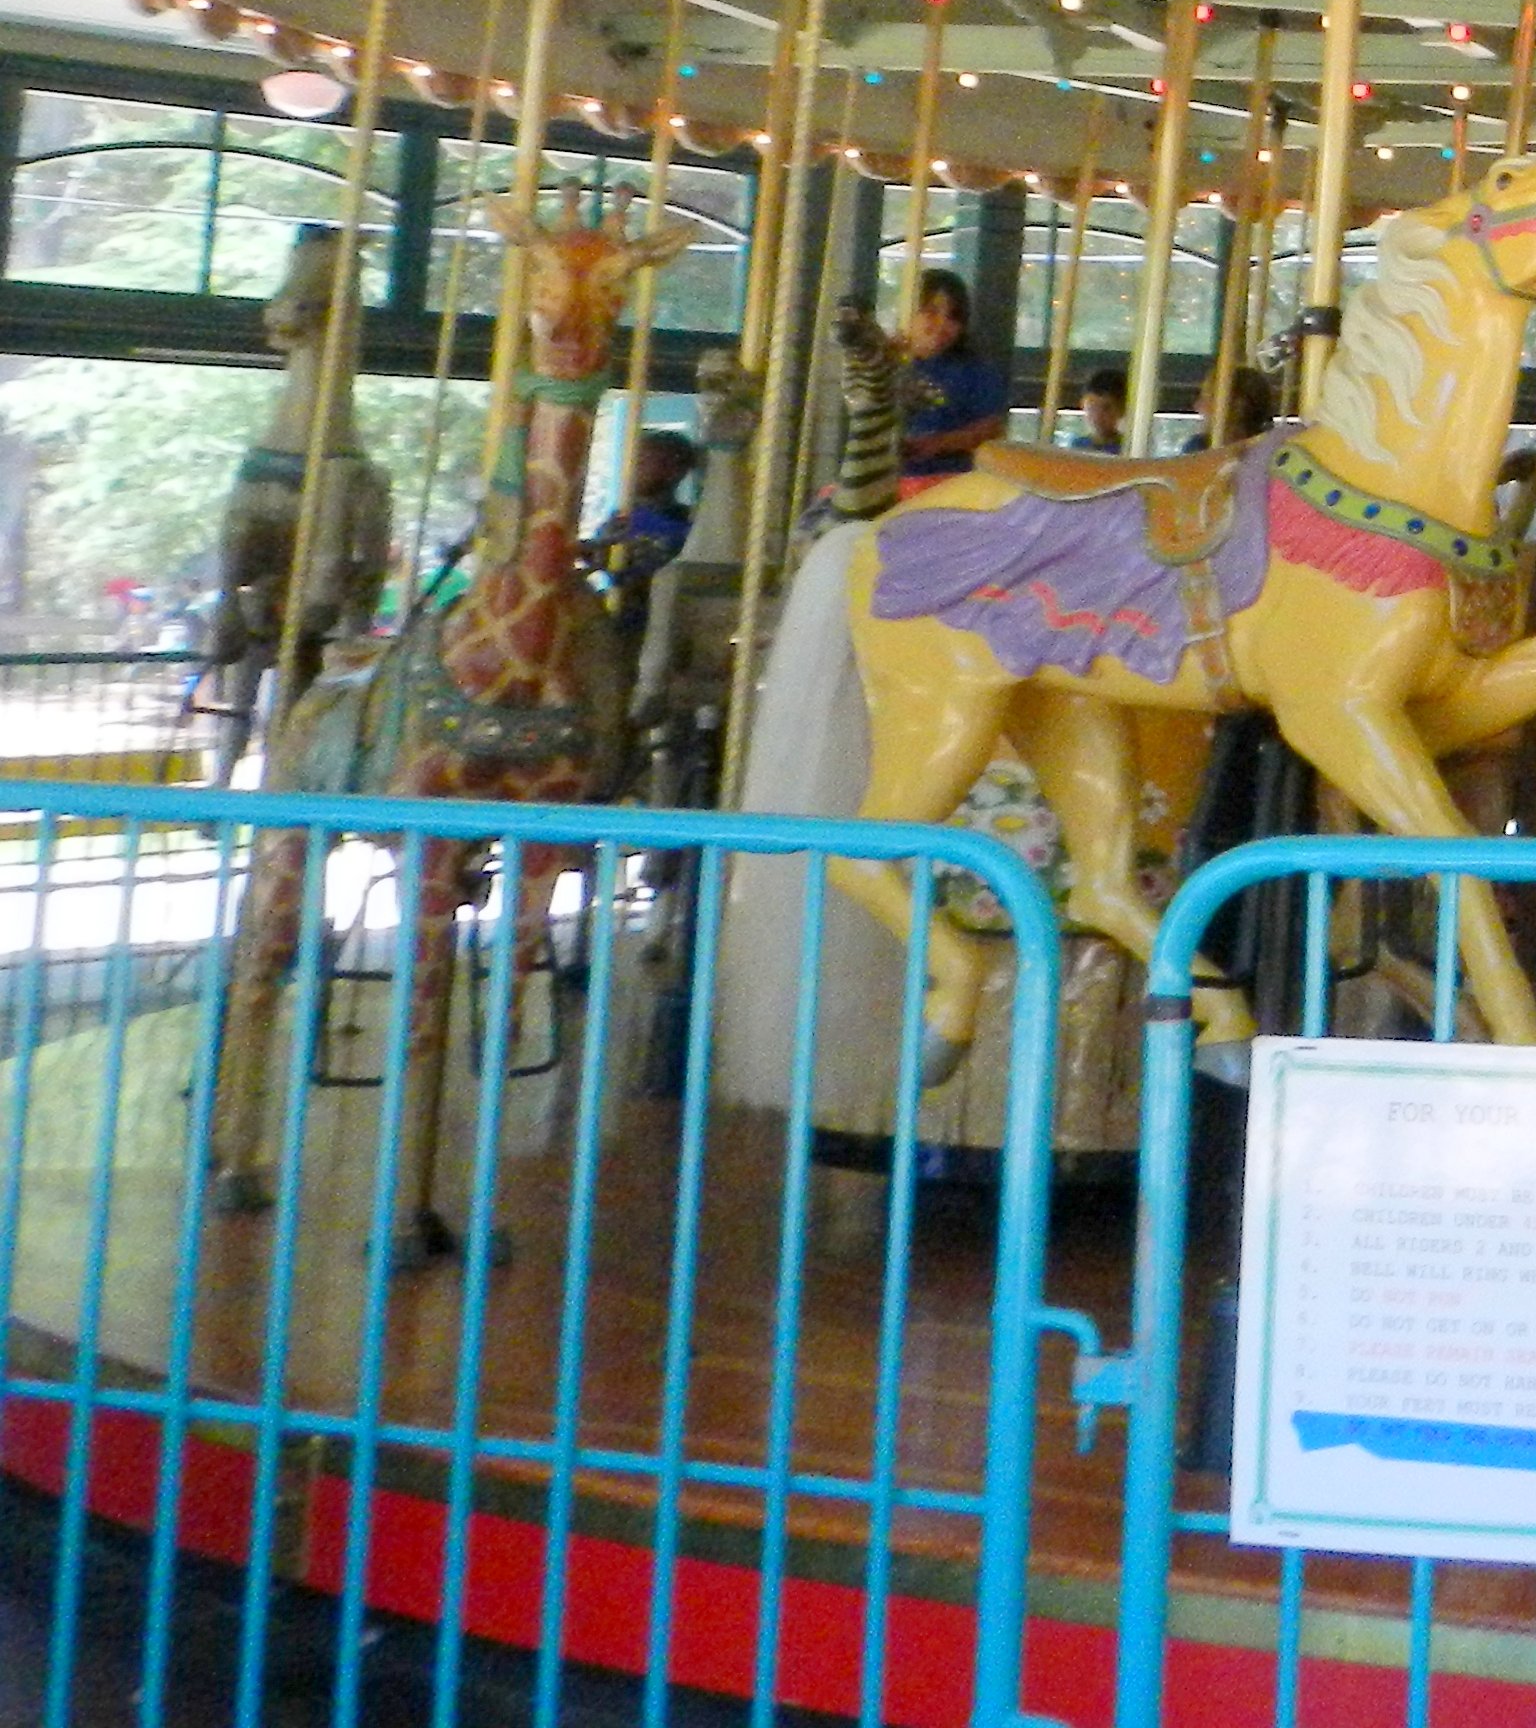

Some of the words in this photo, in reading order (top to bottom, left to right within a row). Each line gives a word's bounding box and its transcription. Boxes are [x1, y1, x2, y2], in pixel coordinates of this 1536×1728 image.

[1352, 1208, 1443, 1227] CHILDREN
[1453, 1213, 1510, 1229] UNDER
[1352, 1235, 1385, 1251] ALL
[1476, 1240, 1486, 1255] 2
[1498, 1241, 1532, 1257] AND
[1406, 1263, 1451, 1280] WILL
[1426, 1317, 1461, 1334] GET
